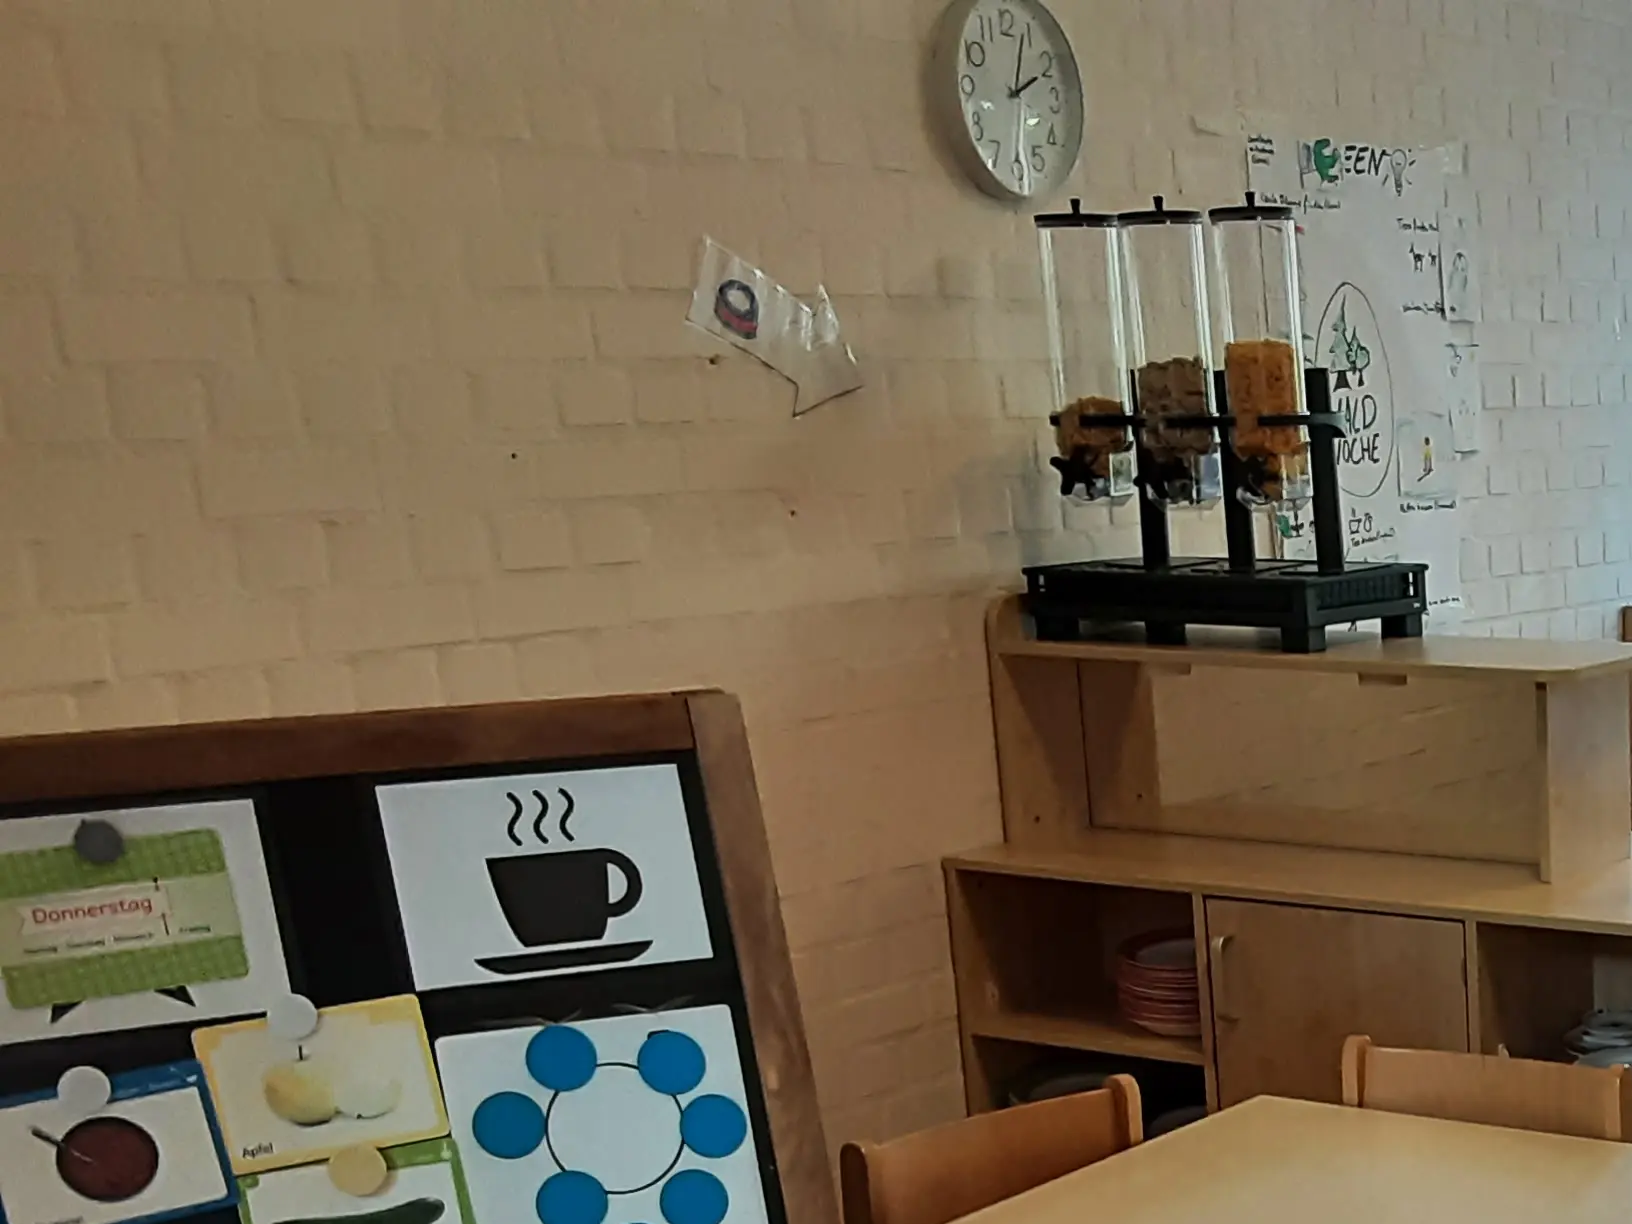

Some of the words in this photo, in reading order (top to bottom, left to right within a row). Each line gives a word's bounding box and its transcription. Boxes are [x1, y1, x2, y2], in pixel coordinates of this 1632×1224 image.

[977, 14, 994, 43] 11
[998, 8, 1015, 38] 12
[964, 39, 986, 68] 10
[1039, 50, 1054, 78] 2
[960, 74, 975, 101] 9
[1049, 86, 1059, 114] 3
[971, 111, 984, 142] 8
[1047, 123, 1057, 145] 4
[988, 140, 1001, 169] 7
[1031, 145, 1045, 172] 5
[1336, 433, 1381, 465] OCHE
[32, 897, 152, 924] Donnerstag
[242, 1142, 275, 1159] Apfel
